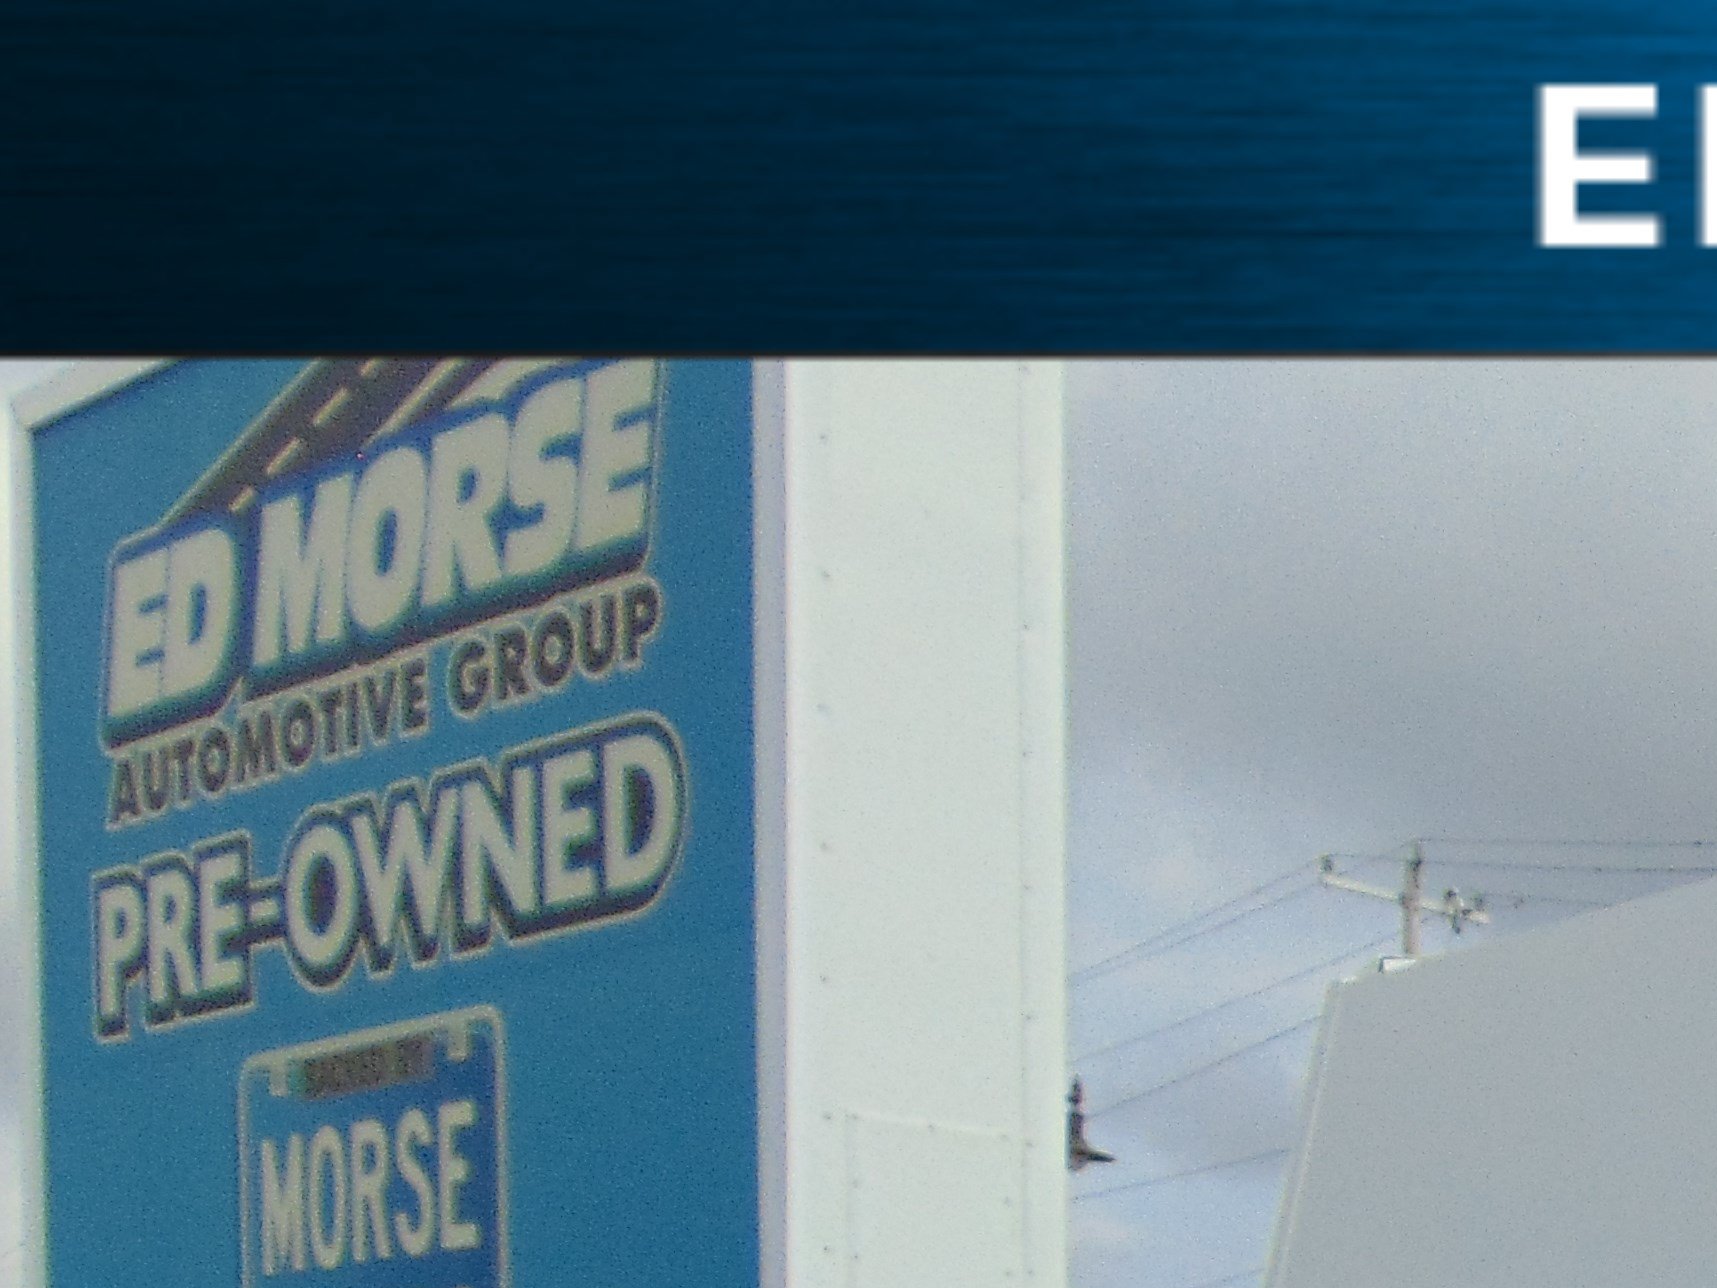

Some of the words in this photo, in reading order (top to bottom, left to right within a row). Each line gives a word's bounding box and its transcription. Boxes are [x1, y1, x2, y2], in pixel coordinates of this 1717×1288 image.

[106, 525, 238, 720] ED
[253, 360, 660, 668] MORSE
[111, 658, 430, 823] AUTOMOTIVE
[451, 584, 660, 714] GROUP
[97, 730, 681, 1022] PRE-OWNED
[260, 1100, 482, 1277] MORSE
